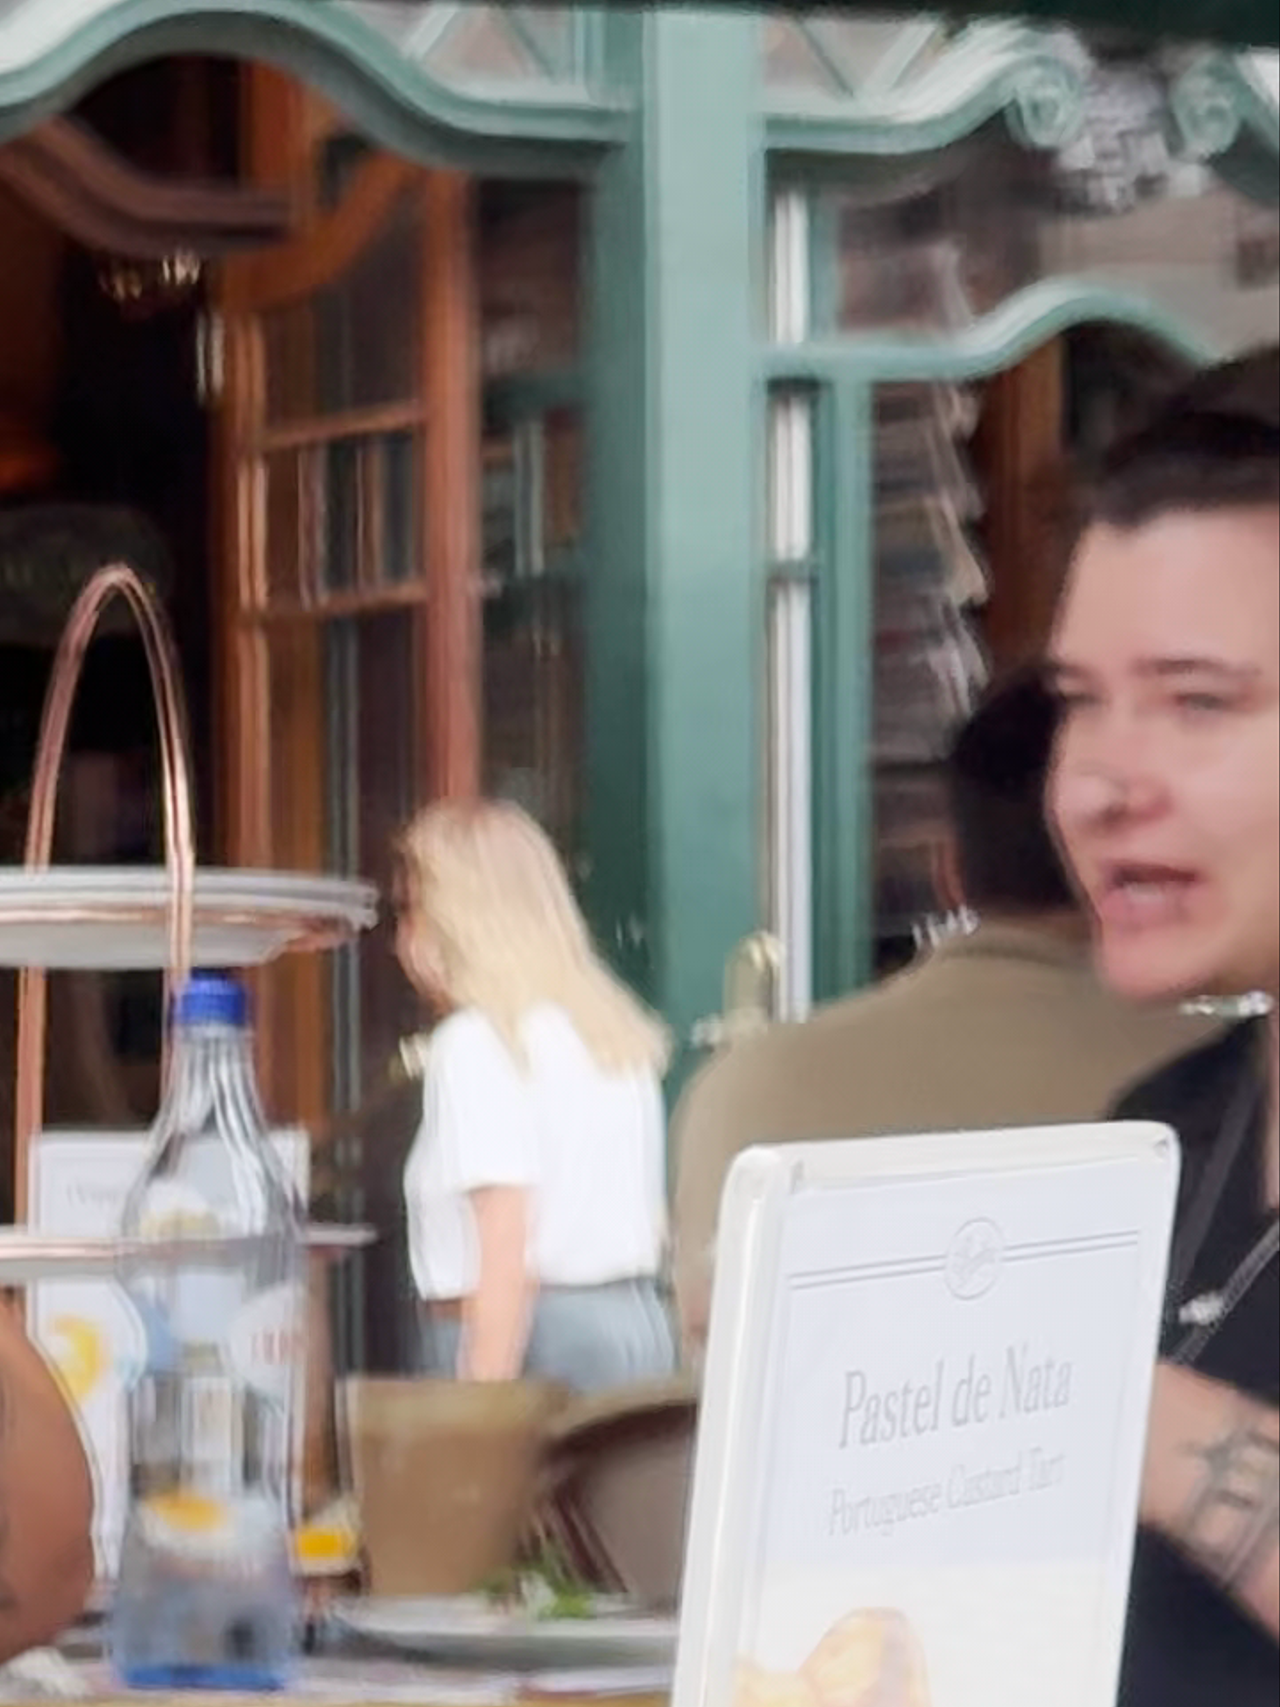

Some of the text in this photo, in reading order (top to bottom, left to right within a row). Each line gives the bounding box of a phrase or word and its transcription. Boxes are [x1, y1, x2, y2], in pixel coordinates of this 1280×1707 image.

[839, 1341, 1073, 1449] Pastel de Nata
